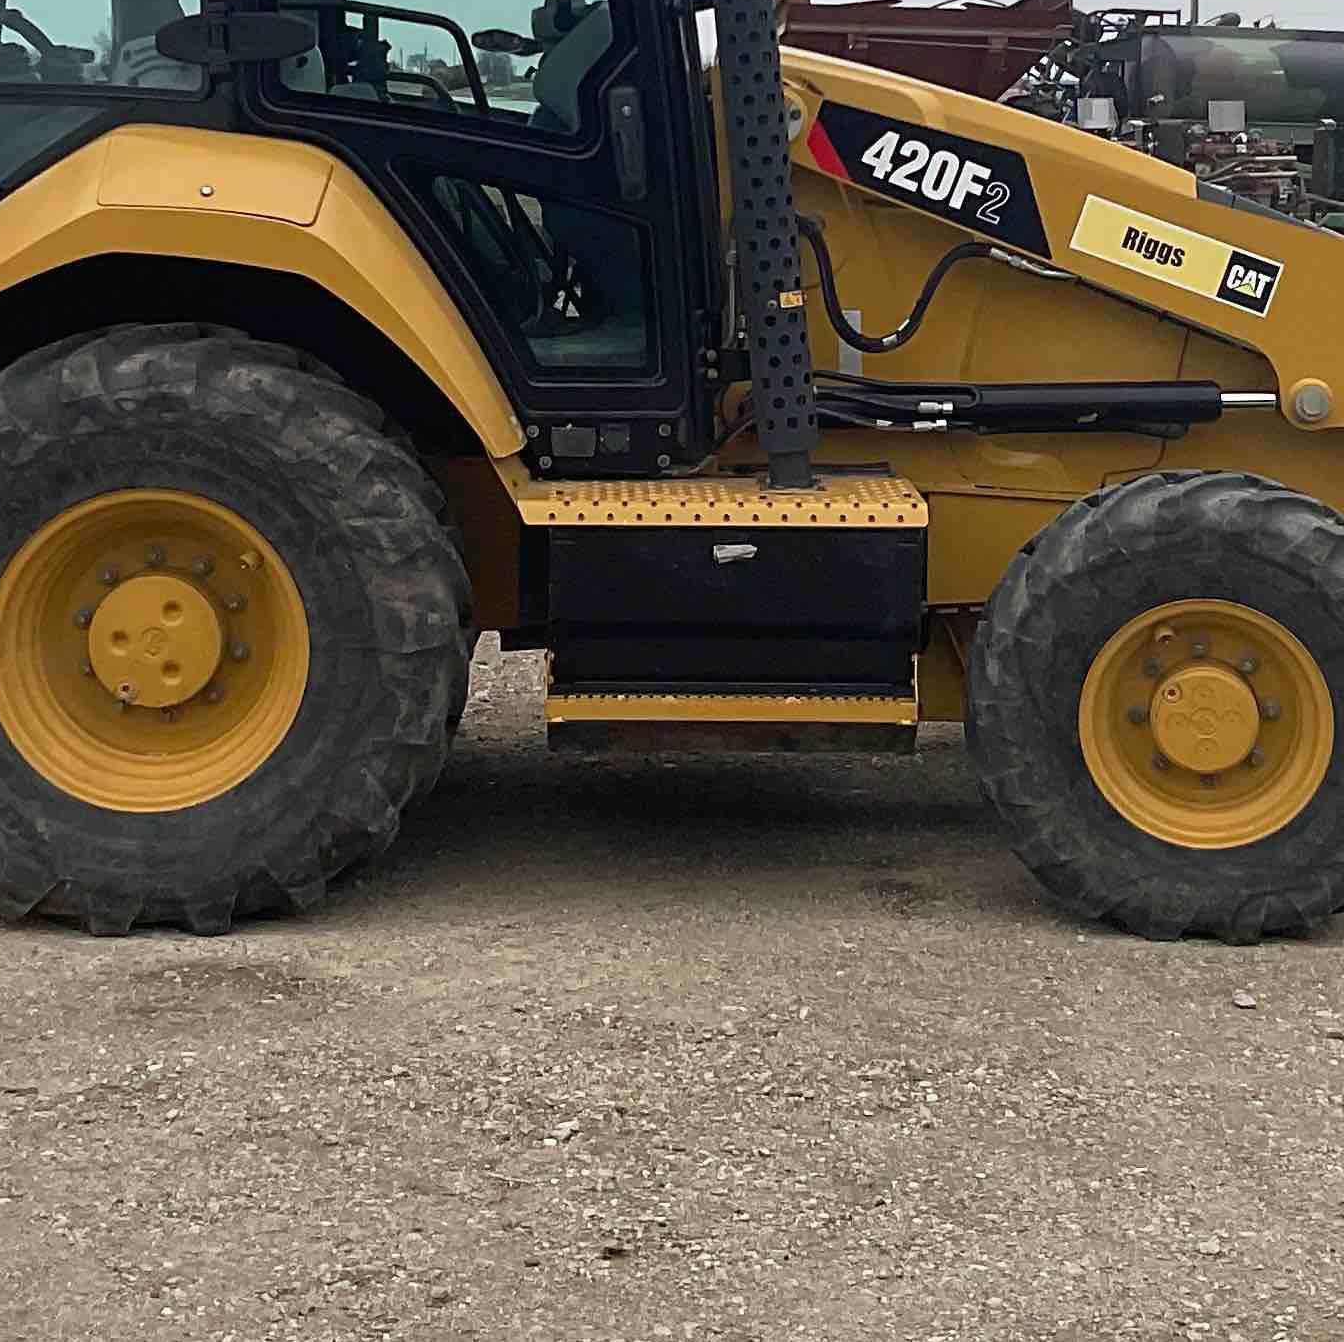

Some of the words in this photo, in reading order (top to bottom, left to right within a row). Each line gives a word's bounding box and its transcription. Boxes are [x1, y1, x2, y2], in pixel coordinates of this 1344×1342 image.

[861, 131, 1010, 225] 420F2
[1121, 226, 1185, 267] Riggs
[1226, 264, 1272, 299] CAT
